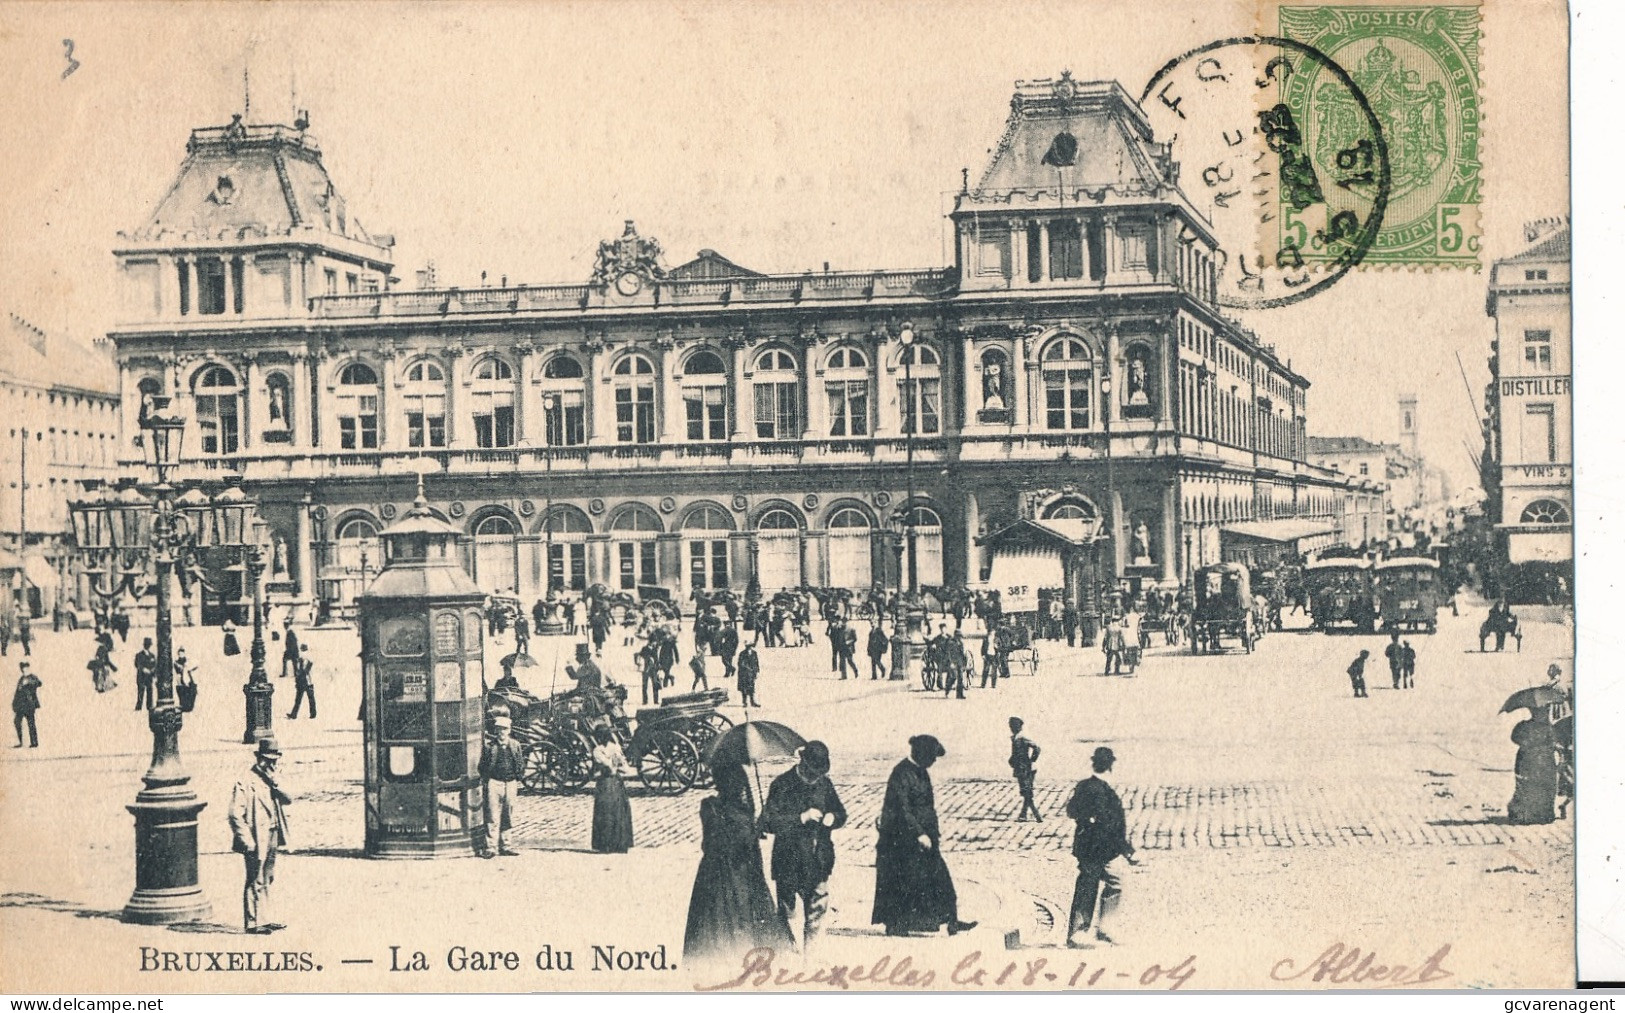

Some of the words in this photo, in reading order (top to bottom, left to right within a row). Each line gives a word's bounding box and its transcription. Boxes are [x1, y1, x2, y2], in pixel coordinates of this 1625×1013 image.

[1347, 11, 1417, 30] POSTES
[61, 38, 80, 80] 3
[1501, 379, 1571, 397] DISTILLER
[1522, 466, 1553, 479] VINS
[693, 946, 936, 991] Bruxelles
[1269, 941, 1455, 988] Albert
